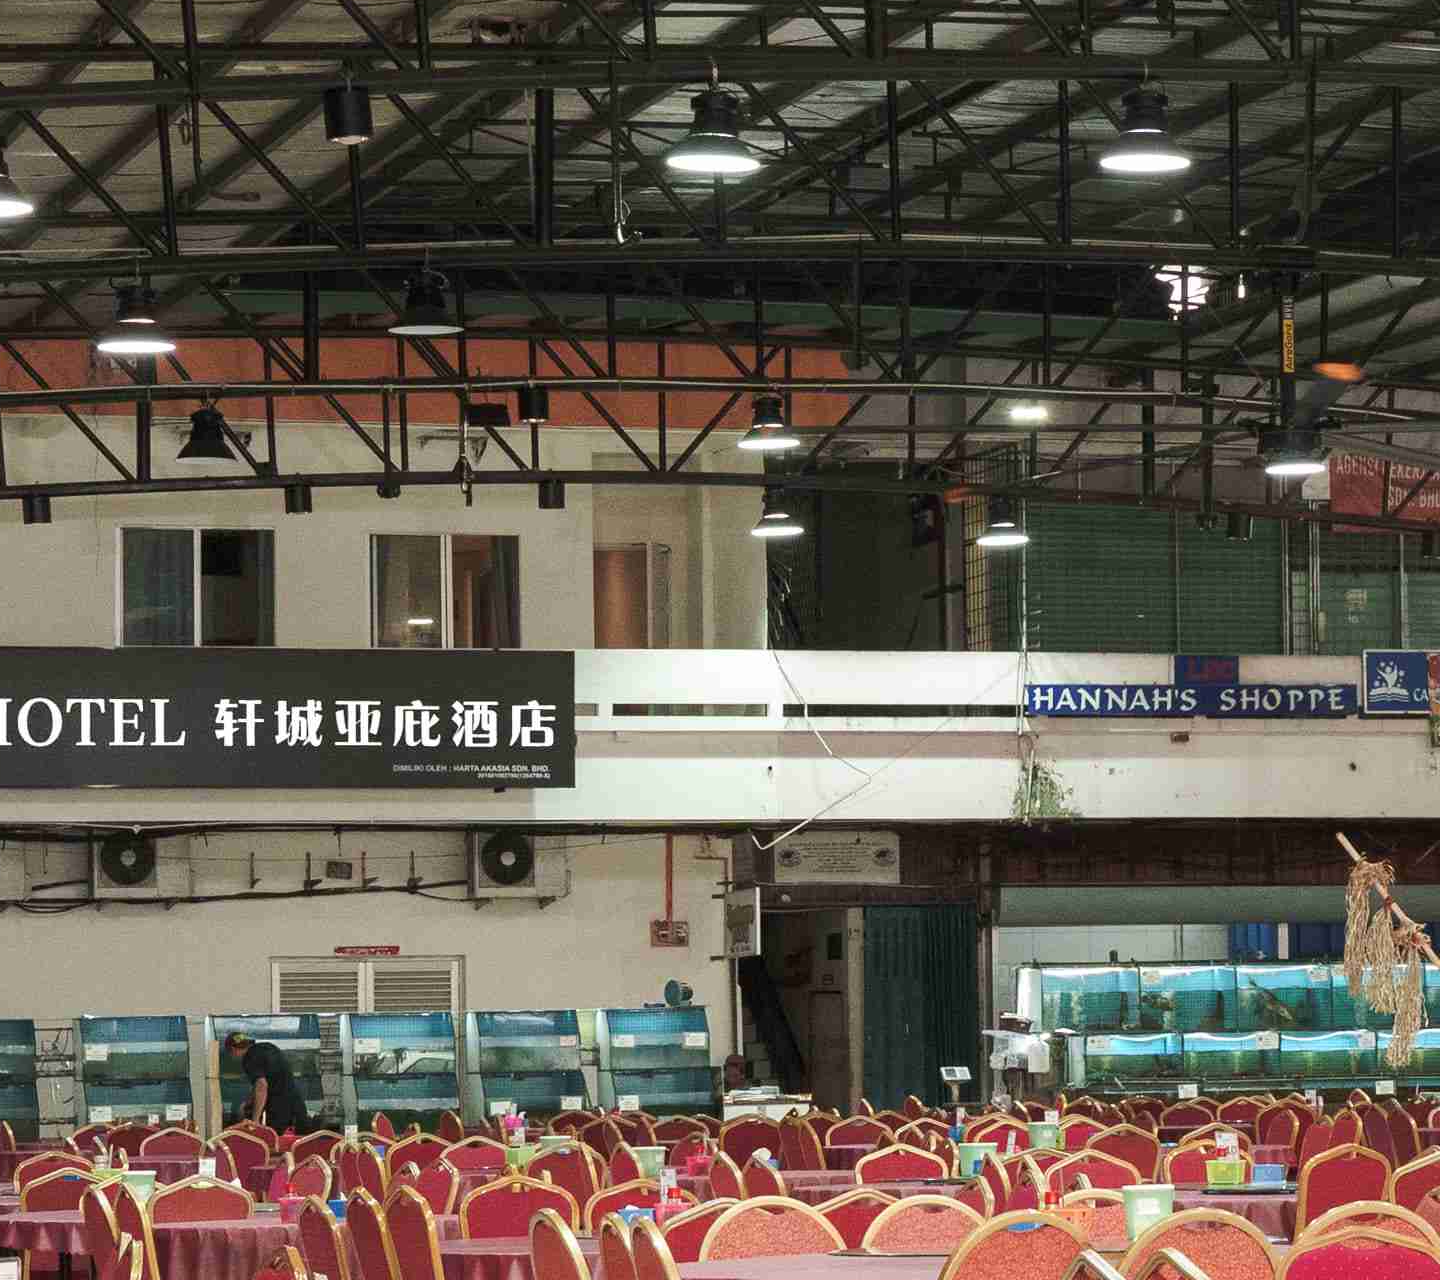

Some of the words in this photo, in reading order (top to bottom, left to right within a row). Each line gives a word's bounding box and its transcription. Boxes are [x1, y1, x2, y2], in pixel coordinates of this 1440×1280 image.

[1032, 686, 1198, 712] HANNAH'S
[1219, 687, 1345, 712] SHOPPE
[213, 699, 558, 747] 轩城亚庇酒店
